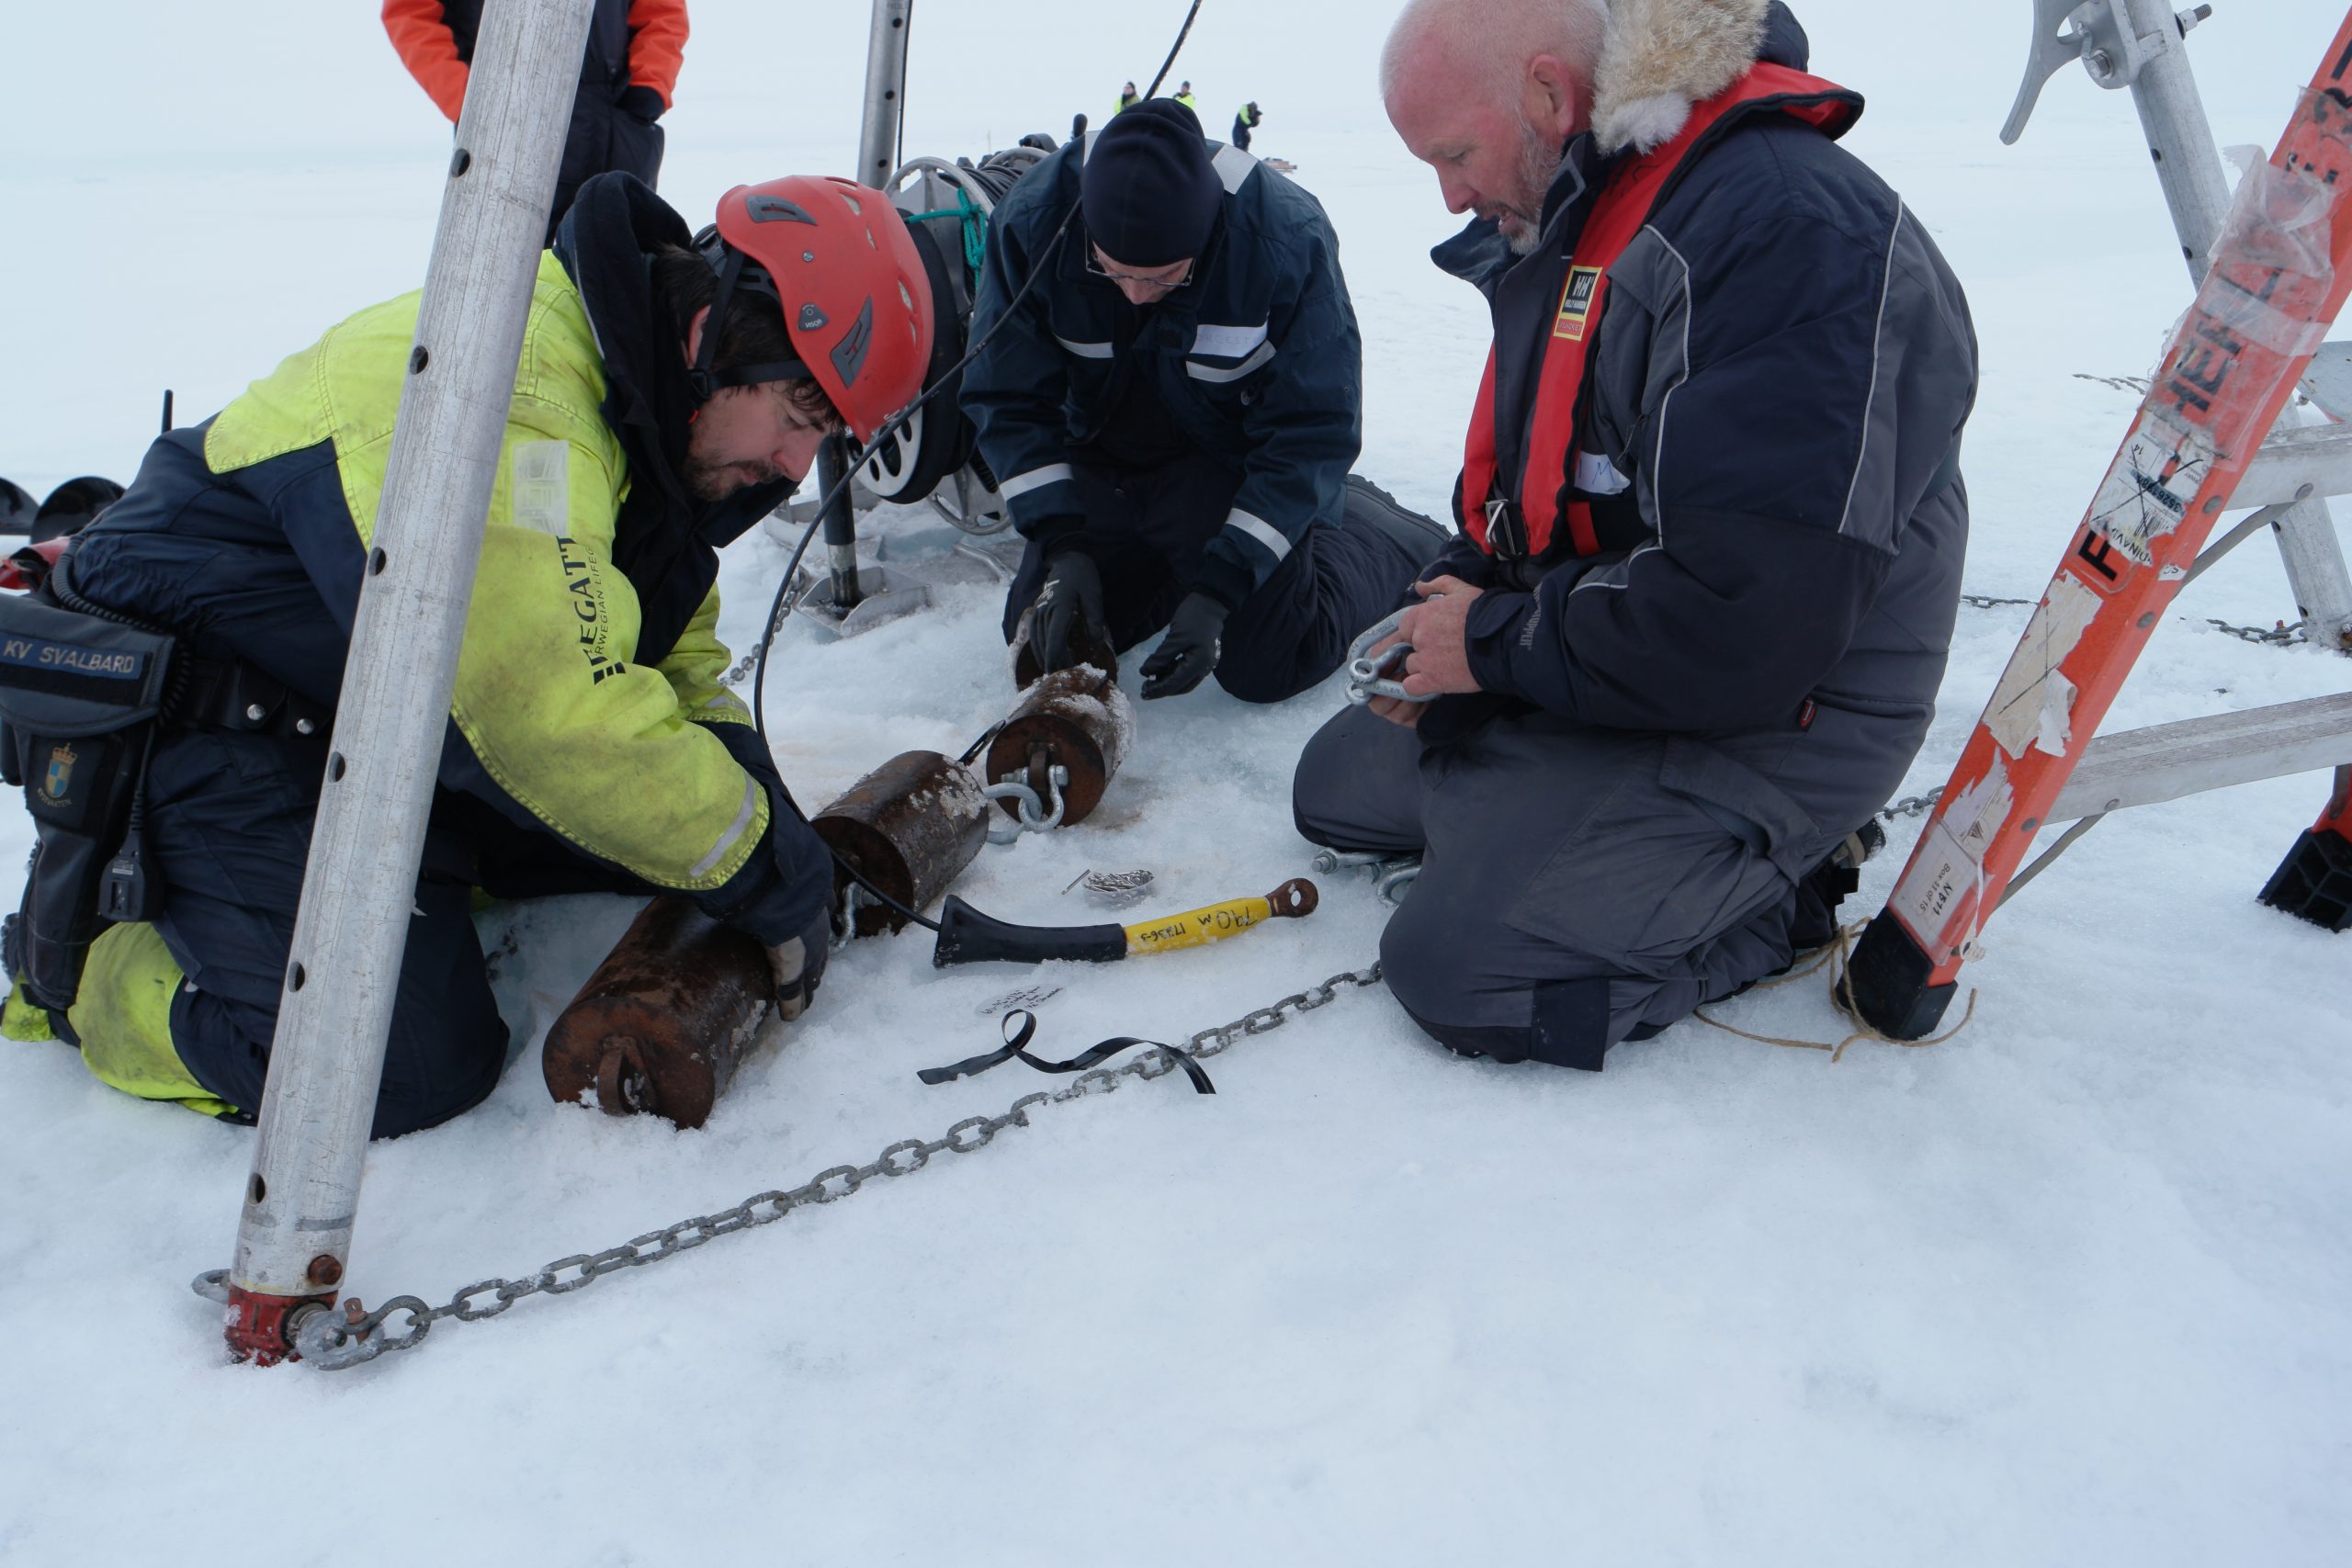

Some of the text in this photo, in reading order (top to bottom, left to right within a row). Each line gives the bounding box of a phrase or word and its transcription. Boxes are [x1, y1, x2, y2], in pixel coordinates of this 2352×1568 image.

[4, 640, 135, 673] KV SVALBARD
[1938, 863, 1951, 881] Box
